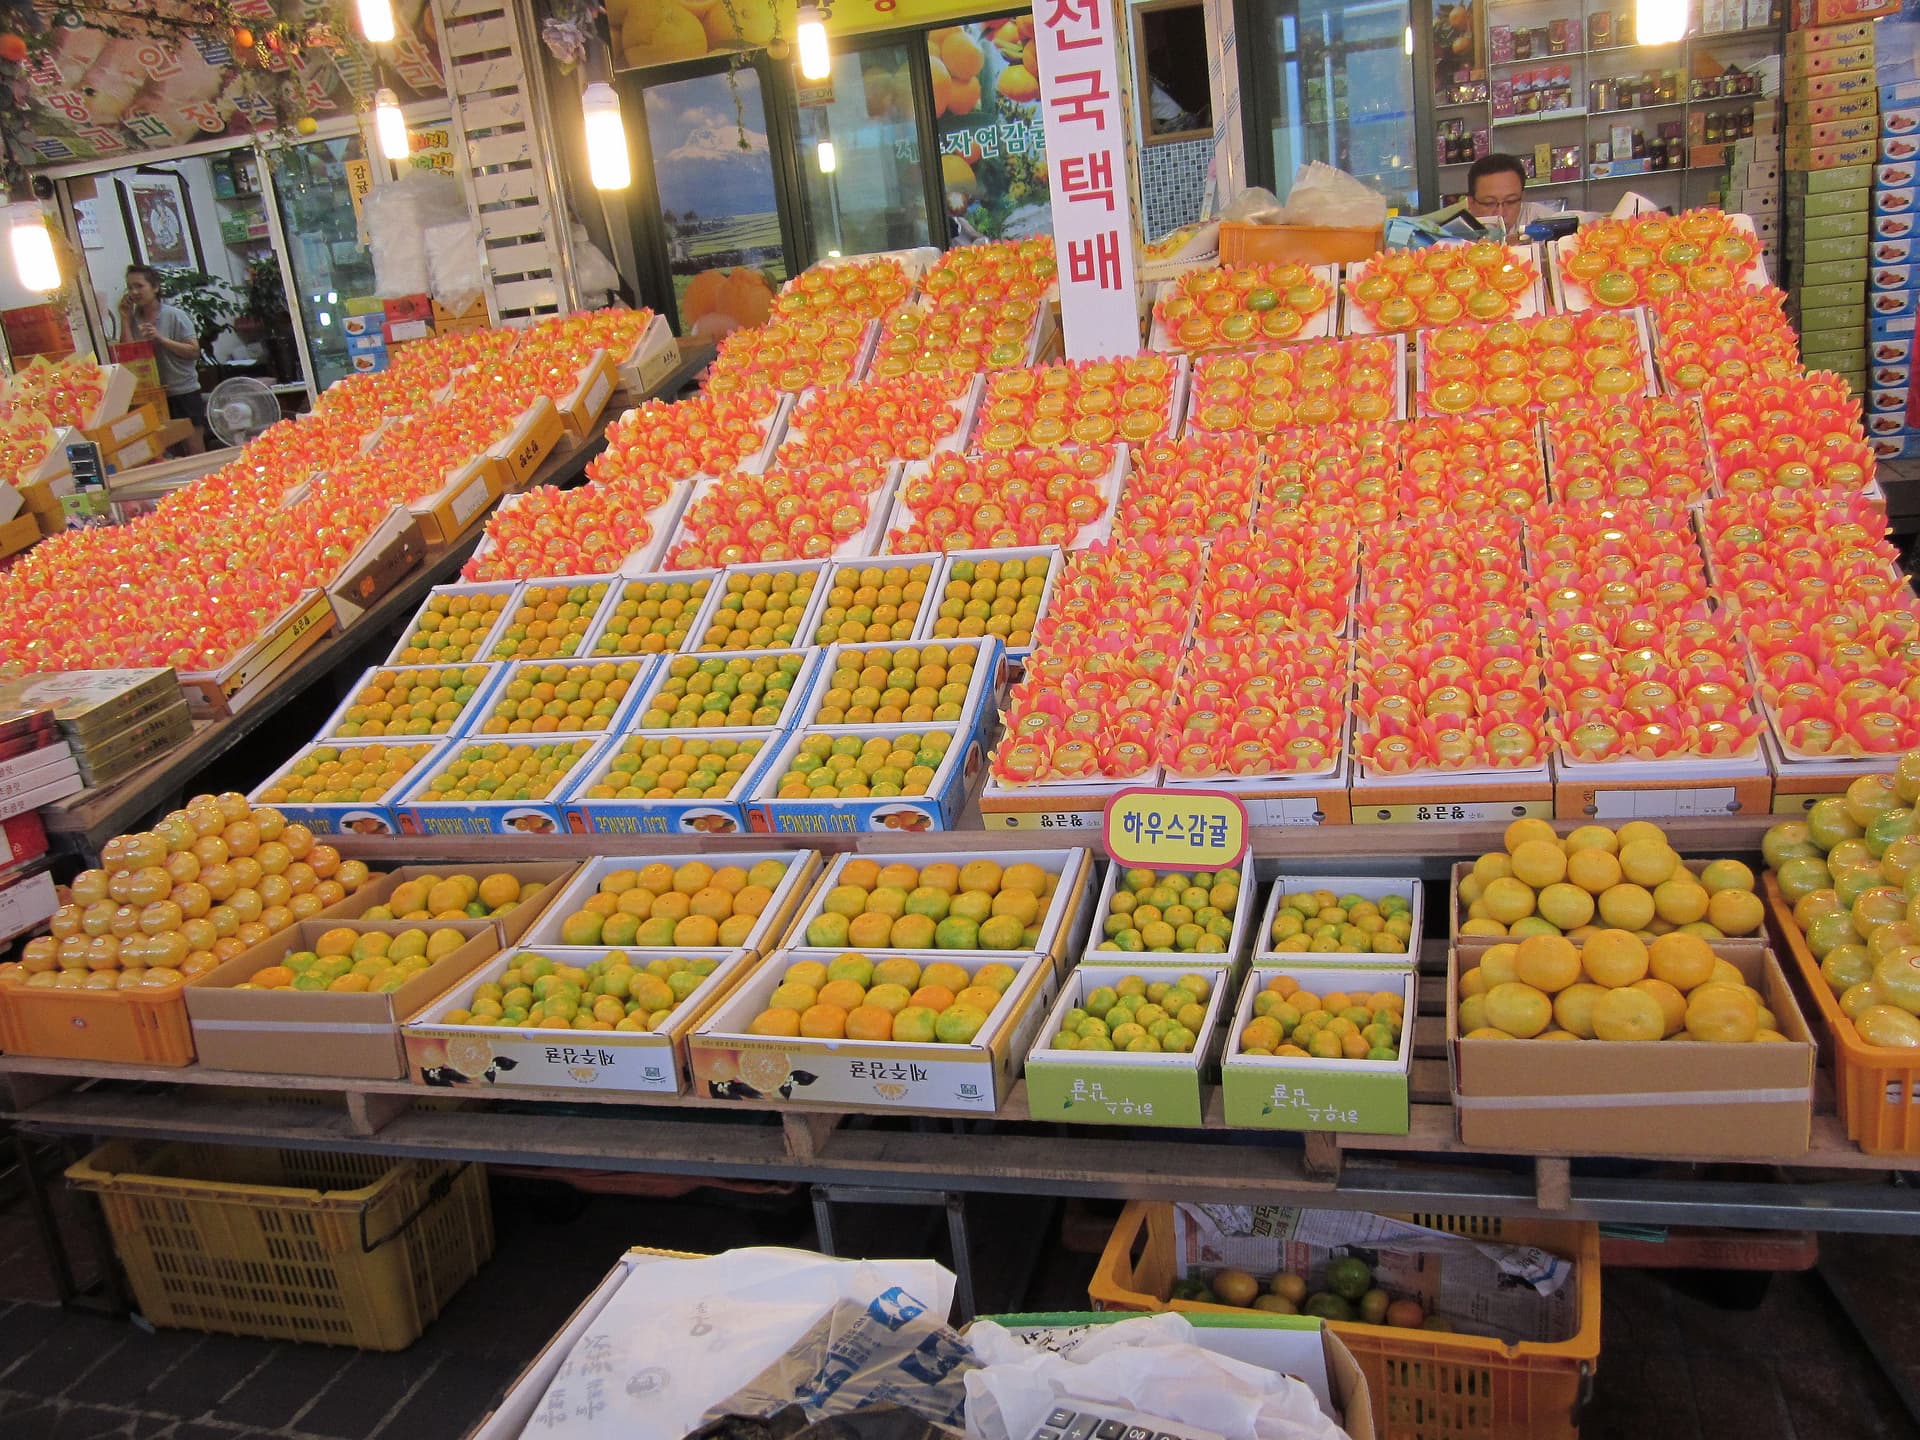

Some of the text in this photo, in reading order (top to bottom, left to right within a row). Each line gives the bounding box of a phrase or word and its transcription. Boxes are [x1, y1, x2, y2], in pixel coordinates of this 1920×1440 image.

[895, 118, 1045, 164] 제자연감귤
[1045, 0, 1122, 290] 전국택배
[1040, 813, 1084, 828] 황금향
[1416, 806, 1465, 820] 황금향
[595, 816, 668, 833] JEJU ORANGE
[778, 814, 858, 832] JEJU ORANGE
[1122, 810, 1228, 848] 하우스감귤
[545, 1047, 615, 1065] 제주감귤
[849, 1060, 928, 1081] 제주감귤
[1071, 1078, 1109, 1102] 감귤
[1270, 1083, 1310, 1108] 감귤
[1105, 1097, 1153, 1116] 하우스
[1307, 1104, 1359, 1123] 하우스
